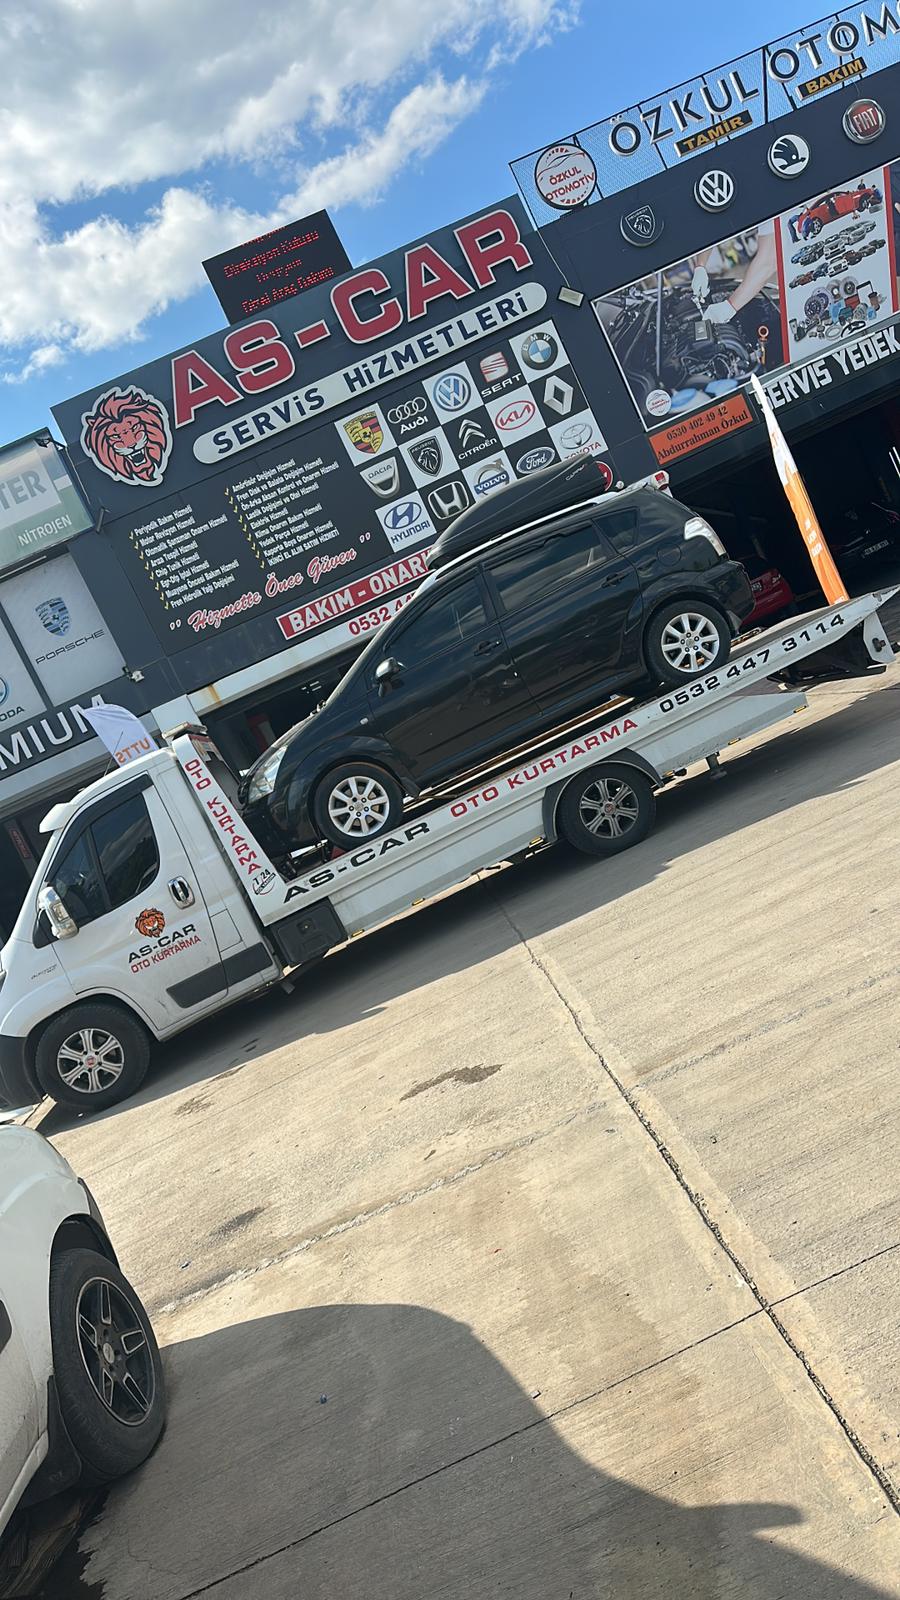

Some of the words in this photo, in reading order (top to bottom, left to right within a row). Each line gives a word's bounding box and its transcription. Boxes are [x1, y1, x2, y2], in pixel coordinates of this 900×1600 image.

[609, 71, 759, 155] ÖZKUL
[768, 0, 900, 83] OTOM
[683, 117, 745, 149] TAMİR
[853, 108, 877, 132] FIAT
[546, 172, 594, 200] OTOMOTİV
[549, 166, 581, 185] ÖZKUL
[172, 209, 534, 430] AS-CAR
[831, 326, 900, 376] YEDEK
[481, 373, 522, 398] SEAT
[400, 416, 429, 434] Audi
[657, 425, 720, 460] Abdurrahman
[721, 410, 749, 430] Özkul
[667, 426, 688, 441] 0530
[689, 418, 704, 430] 402
[705, 412, 716, 423] 49
[716, 406, 728, 417] 42
[367, 464, 393, 479] DACIA
[476, 473, 507, 492] VOLVO
[18, 514, 72, 546] NİTROJEN
[391, 520, 430, 545] HYUNDAI
[188, 591, 261, 632] Hizmette
[265, 571, 304, 598] Önce
[307, 549, 357, 583] Güven
[289, 591, 352, 633] BAKIM
[348, 607, 391, 636] 0532
[35, 629, 105, 664] PORSCHE
[283, 821, 431, 903] AS-CAR
[450, 785, 500, 818] OTO
[507, 717, 639, 789] KURTARMA
[659, 676, 721, 714] 0532
[726, 649, 771, 678] 447
[781, 613, 845, 652] 3114
[184, 758, 212, 791] OTO
[206, 796, 262, 875] KURTARMA
[128, 923, 196, 964] AS-CAR
[131, 958, 151, 974] OTO
[151, 935, 202, 964] KURTARMA
